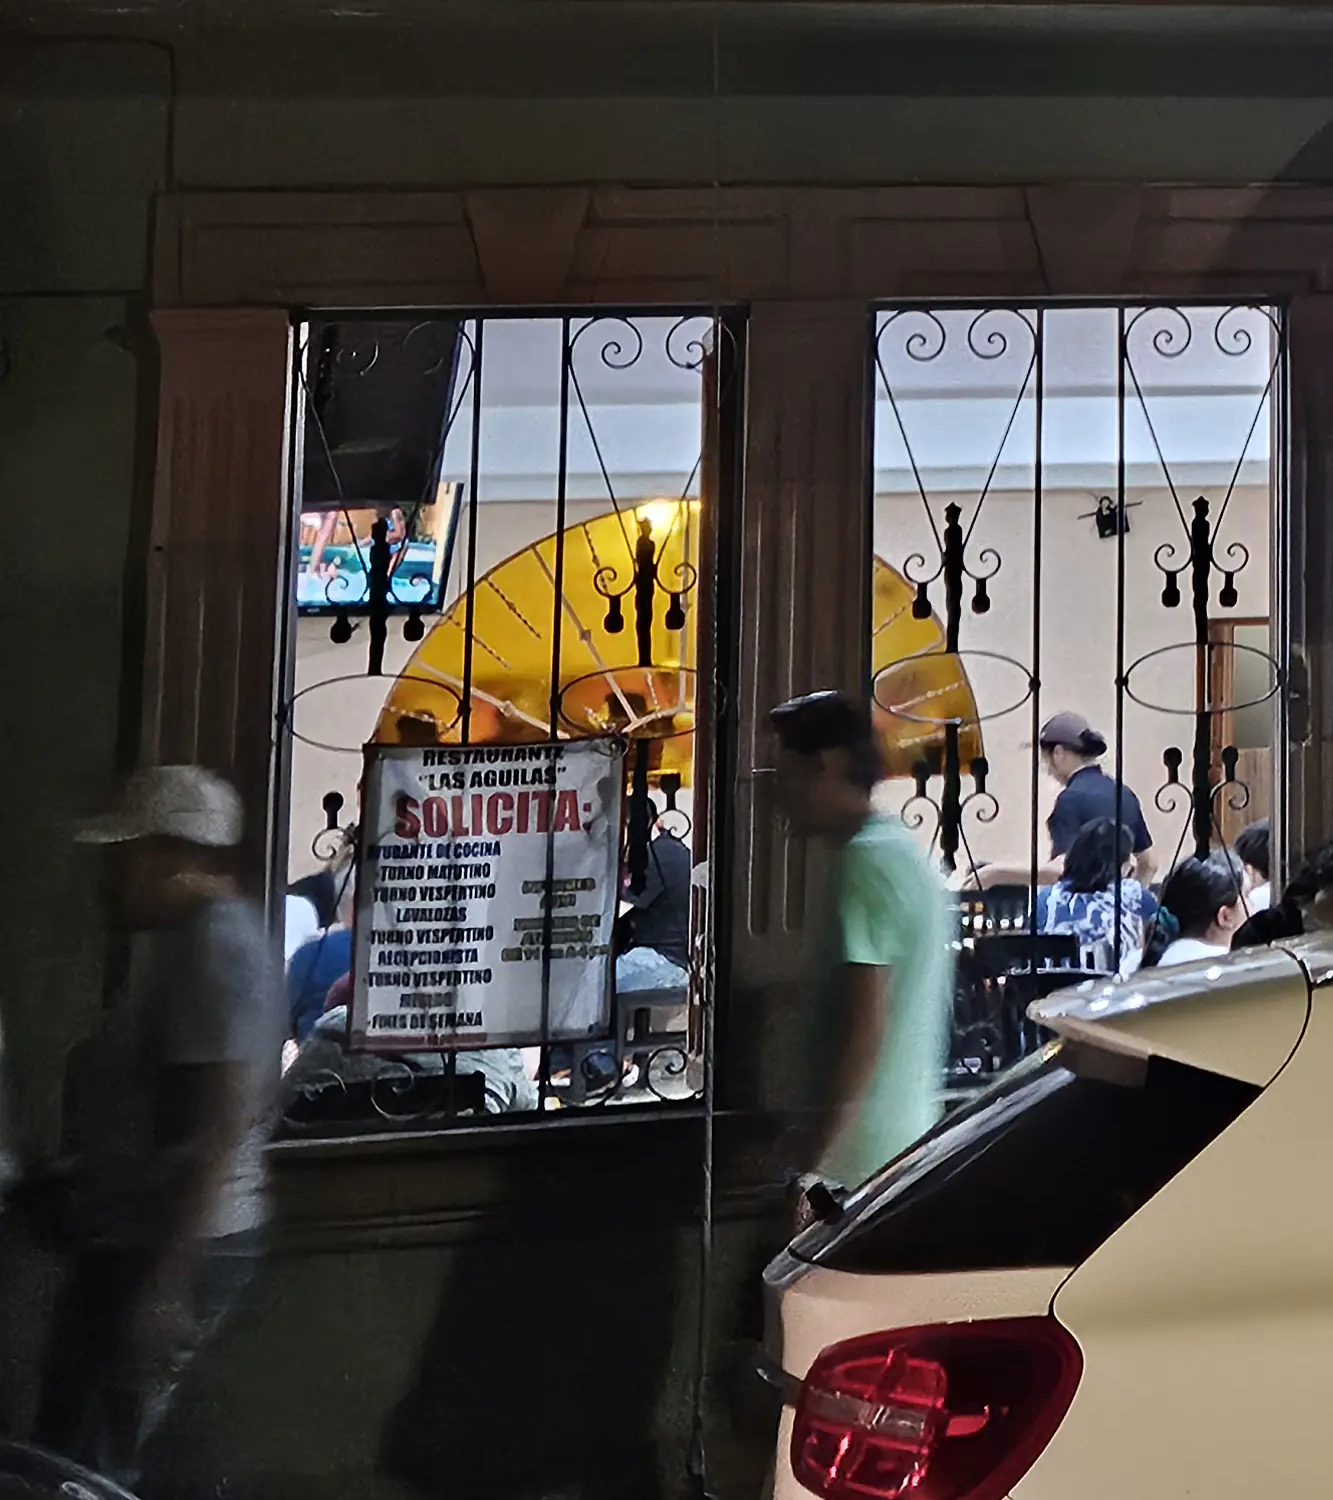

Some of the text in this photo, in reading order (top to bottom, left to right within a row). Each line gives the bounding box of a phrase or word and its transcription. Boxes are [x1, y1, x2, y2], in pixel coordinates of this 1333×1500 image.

[422, 746, 565, 766] RESTAURANTE
[394, 789, 592, 838] SOLICITA:
[453, 841, 501, 859] COCINA
